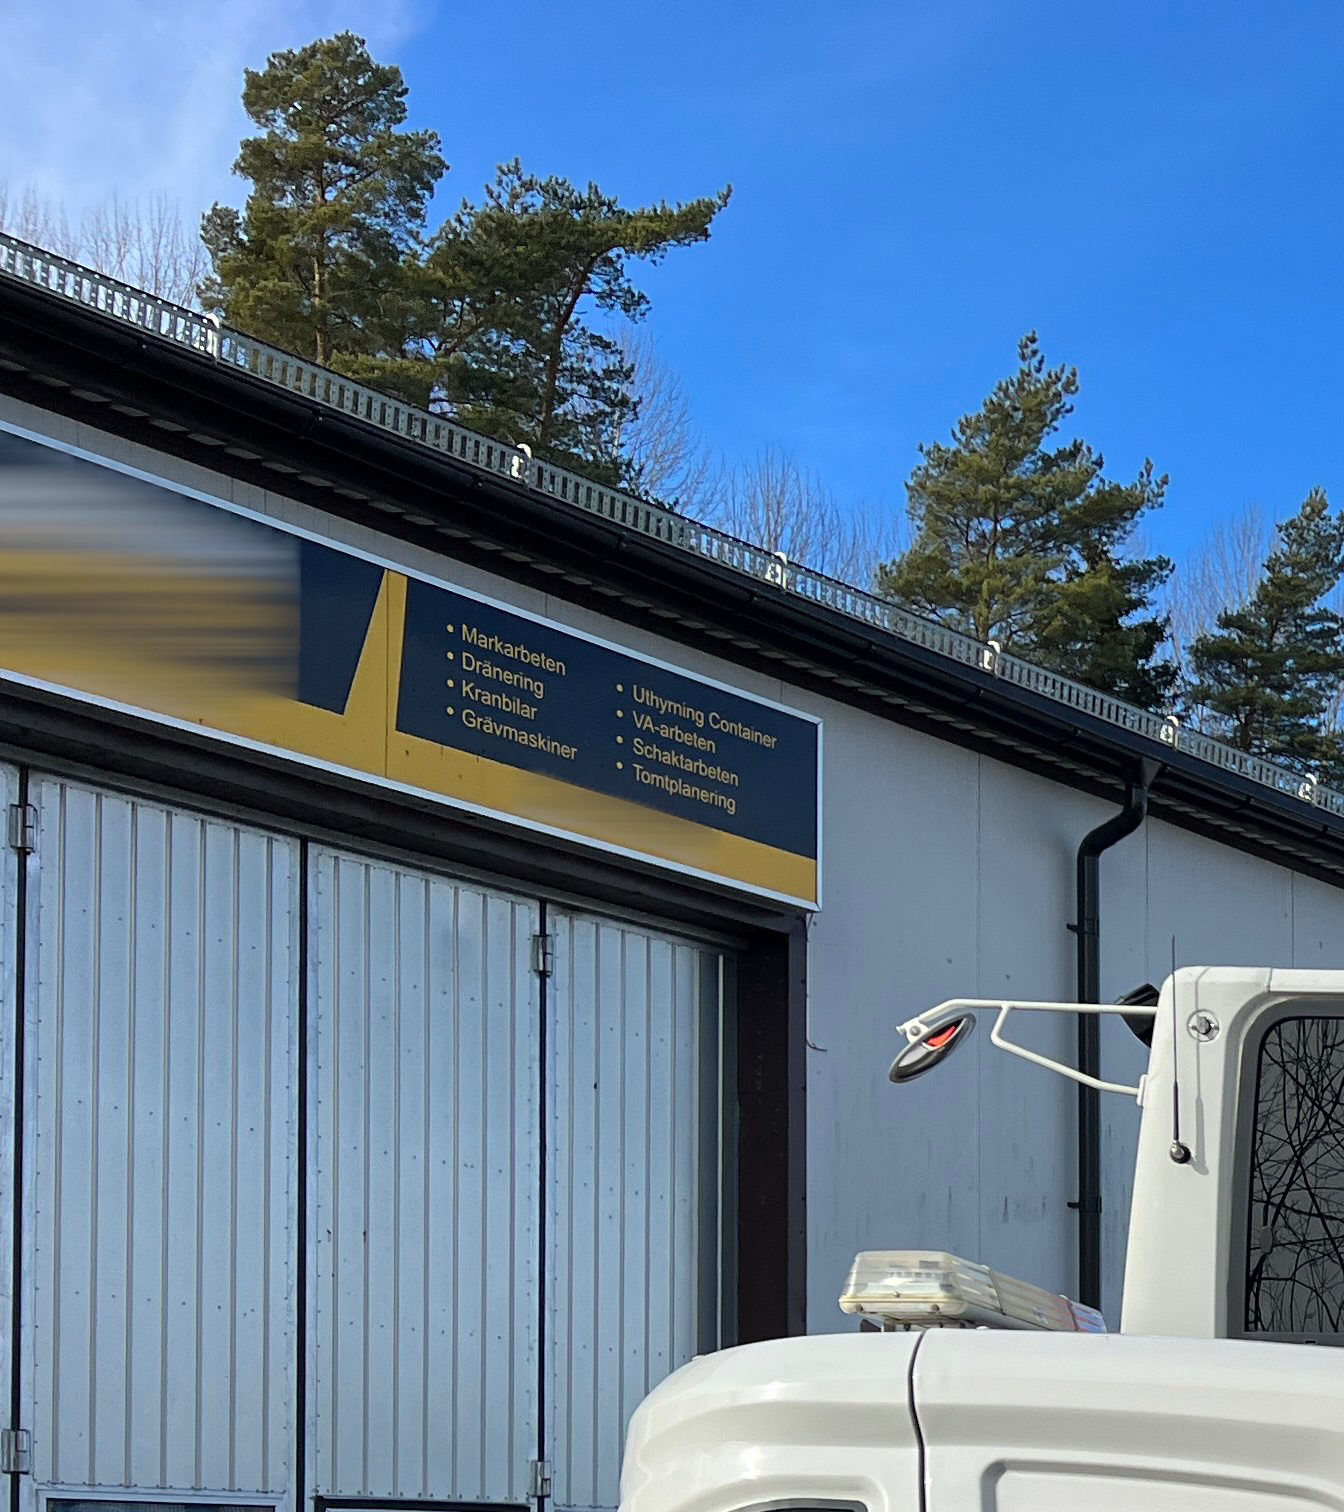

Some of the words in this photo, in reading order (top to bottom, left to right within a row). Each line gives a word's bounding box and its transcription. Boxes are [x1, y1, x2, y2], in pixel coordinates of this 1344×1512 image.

[462, 624, 566, 676] Markarbeten
[462, 652, 544, 699] Dränering
[462, 680, 538, 720] Kranbilar
[462, 709, 577, 760] Grävmaskiner
[633, 710, 716, 753] VA-arbeten
[708, 712, 778, 749] Container
[633, 738, 739, 787] Schaktarbeten
[633, 764, 736, 815] Tomtplanering
